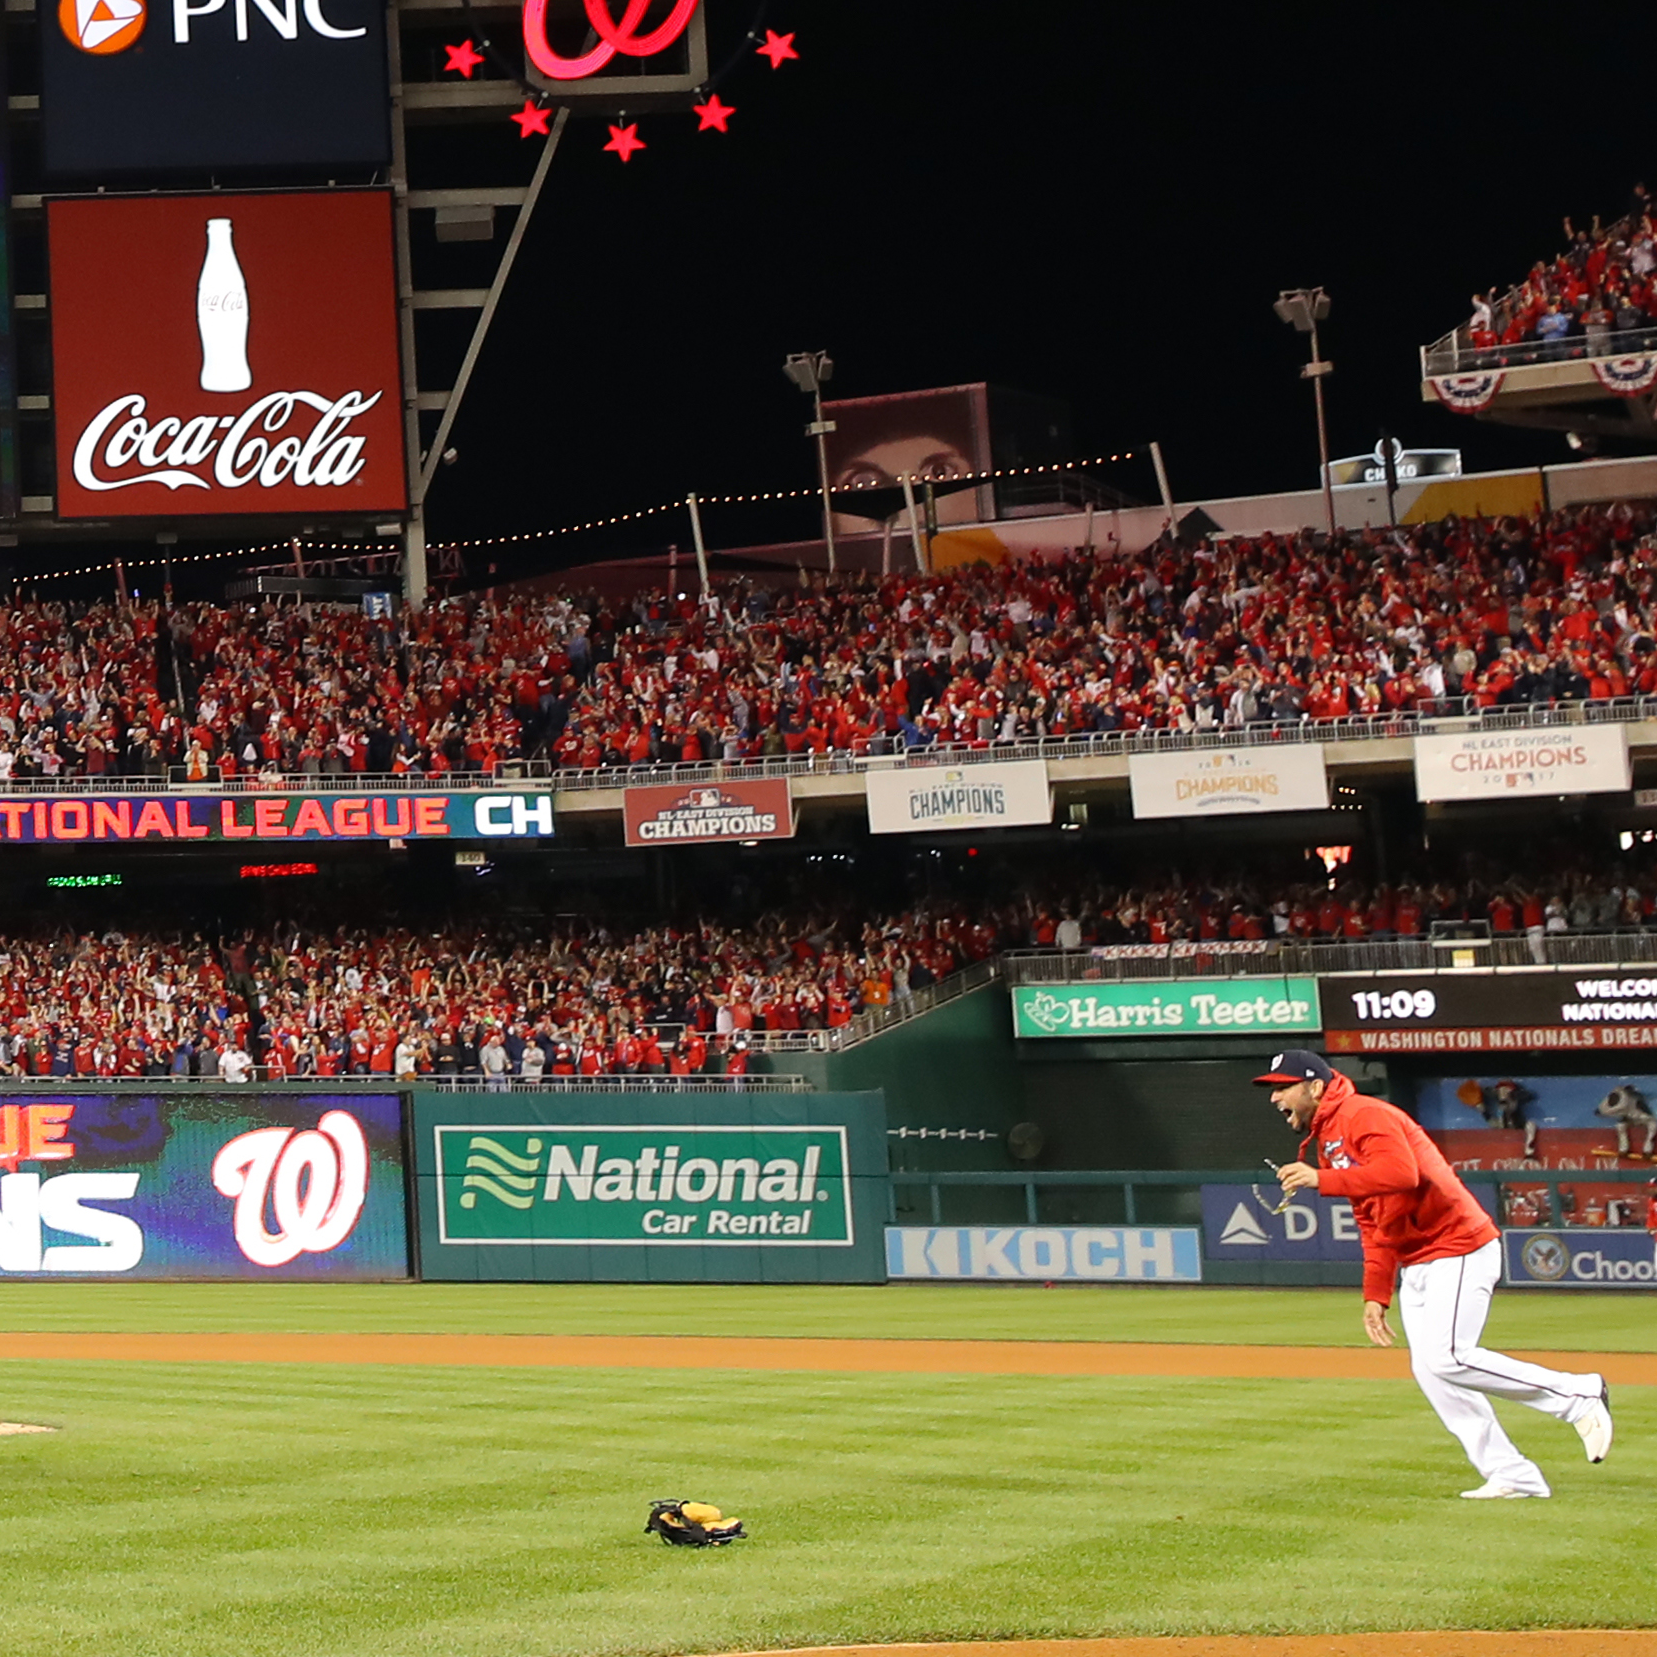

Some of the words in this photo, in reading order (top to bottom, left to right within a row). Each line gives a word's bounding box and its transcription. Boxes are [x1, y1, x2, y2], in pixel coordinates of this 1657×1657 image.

[73, 390, 383, 491] Coca-Cola
[1451, 747, 1587, 772] CHAMPIONS
[1176, 774, 1279, 801] CHAMPIONS
[222, 796, 448, 837] LEAGUE
[475, 795, 553, 835] CH
[910, 789, 1005, 820] CHAMPIONS
[639, 814, 776, 839] CHAMPIONS
[1068, 997, 1182, 1028] Harris
[1190, 994, 1309, 1025] Teeter
[1351, 989, 1436, 1019] 11:09
[1360, 1031, 1482, 1050] WASHINGTON
[1488, 1027, 1594, 1048] NATIONALS
[545, 1144, 820, 1205] National
[642, 1209, 696, 1234] Car
[706, 1207, 811, 1235] Rental
[970, 1229, 1174, 1276] KOCH
